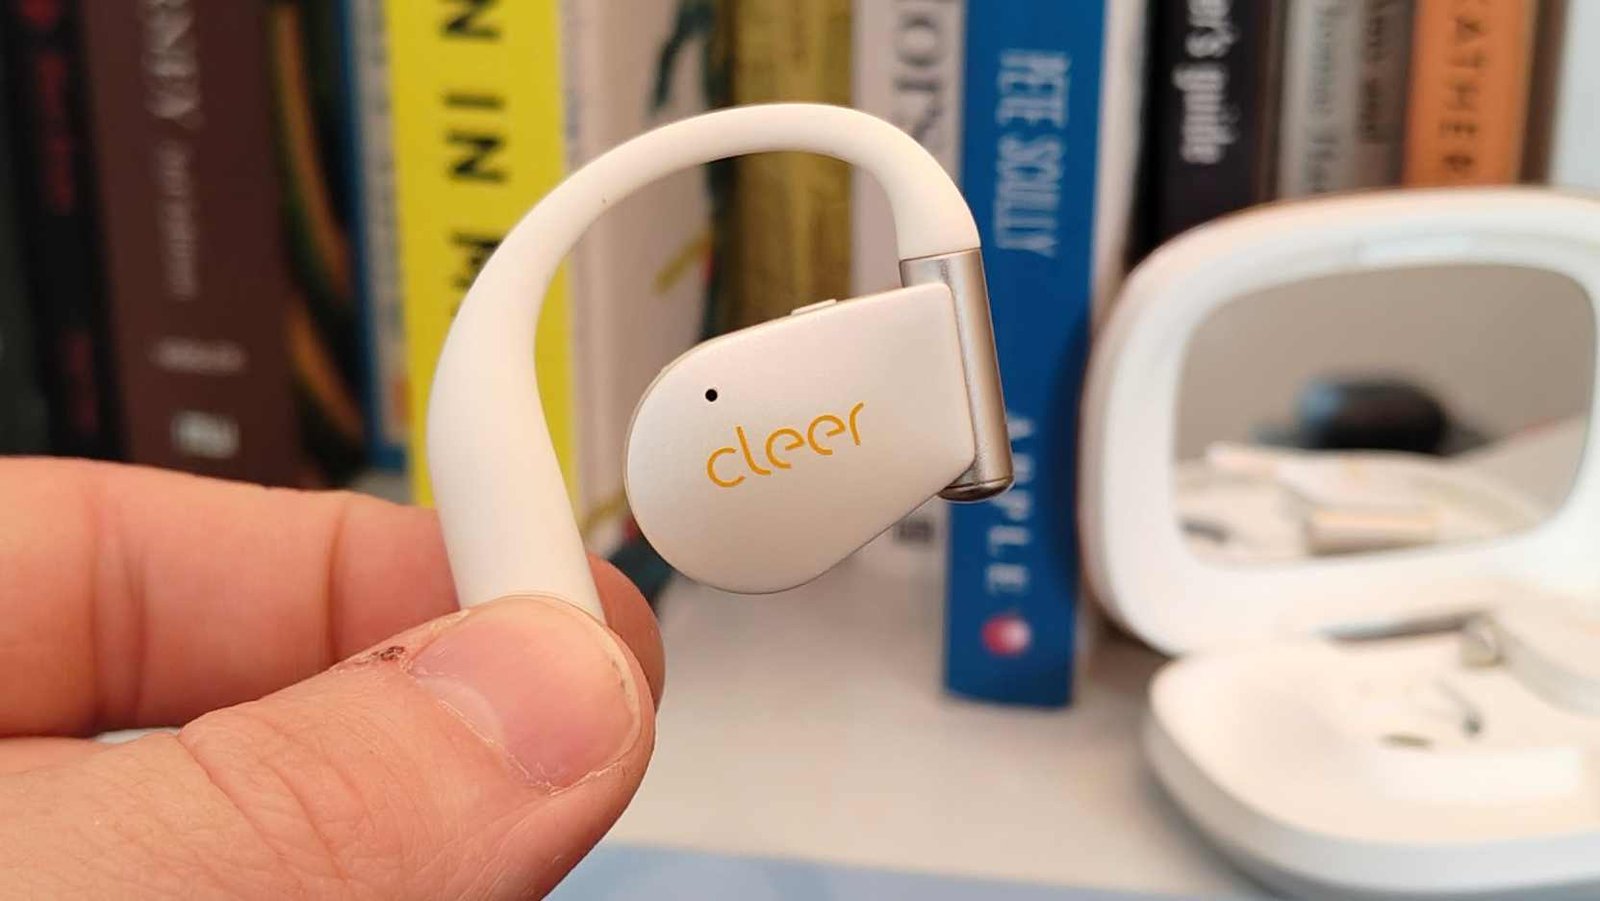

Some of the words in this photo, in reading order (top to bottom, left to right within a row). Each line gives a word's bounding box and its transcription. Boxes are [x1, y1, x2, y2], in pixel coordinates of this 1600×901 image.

[995, 49, 1070, 127] PETE
[1171, 63, 1240, 165] guide
[442, 92, 510, 185] IN
[993, 134, 1067, 258] SCULLY
[706, 401, 864, 488] cleer
